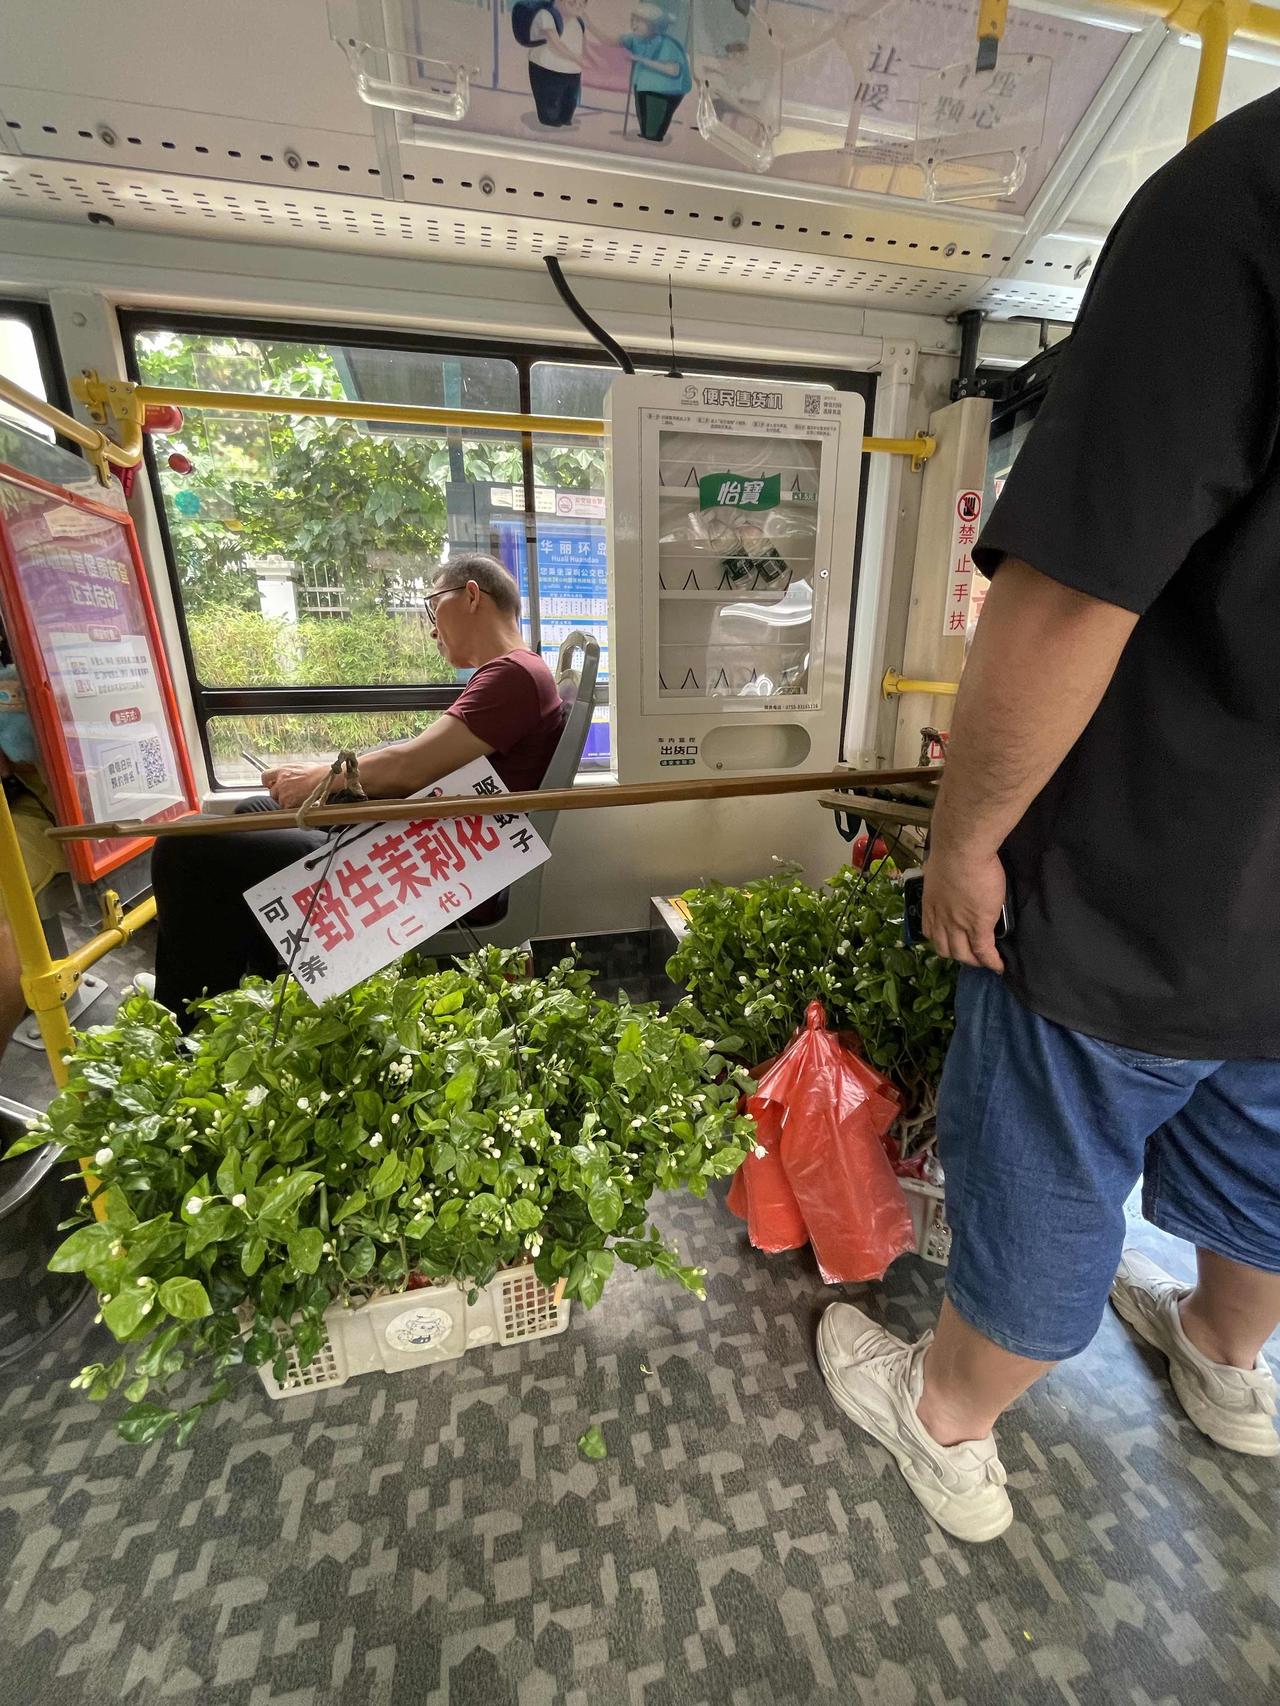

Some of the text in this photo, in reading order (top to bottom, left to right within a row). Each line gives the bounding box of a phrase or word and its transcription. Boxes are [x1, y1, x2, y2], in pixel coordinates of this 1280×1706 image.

[702, 387, 783, 410] 便民售货机
[717, 480, 764, 505] 怡寶
[540, 539, 607, 557] 华丽环岛
[950, 524, 975, 631] 禁止手扶
[660, 745, 698, 756] 出货口
[290, 812, 502, 953] 野生茉莉花
[258, 895, 328, 985] 可水养
